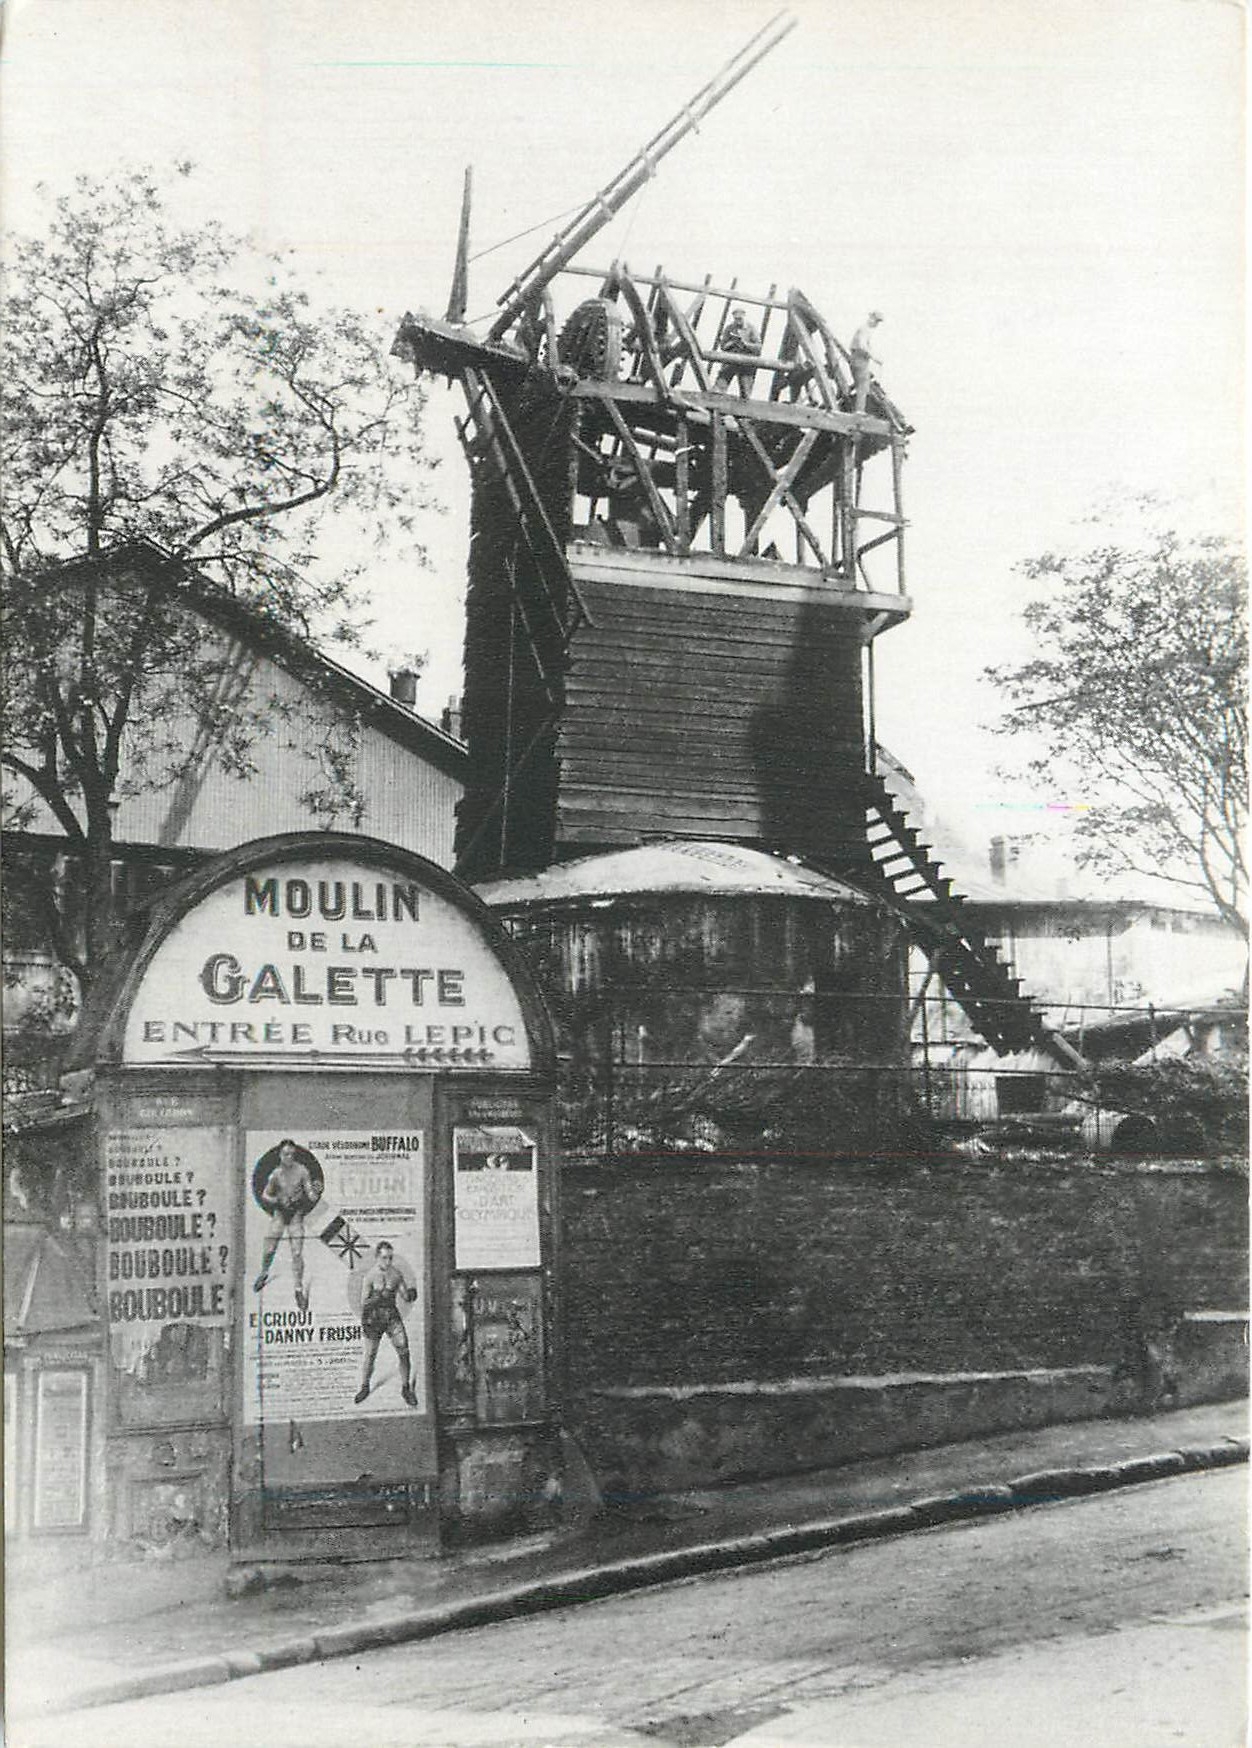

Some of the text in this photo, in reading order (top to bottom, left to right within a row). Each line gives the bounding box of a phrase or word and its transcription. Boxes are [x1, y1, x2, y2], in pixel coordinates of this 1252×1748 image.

[243, 876, 420, 922] MOULIN
[287, 930, 379, 953] DE LA
[198, 952, 467, 1007] GALETTE
[142, 1016, 517, 1047] ENTRÉE Rue LEPIC
[371, 1135, 419, 1152] BUFFALO
[108, 1213, 203, 1244] BOUBOULE
[109, 1247, 213, 1281] BOUBOULE
[109, 1284, 226, 1323] BOUBOULE
[265, 1325, 361, 1344] DANNY FRUSH
